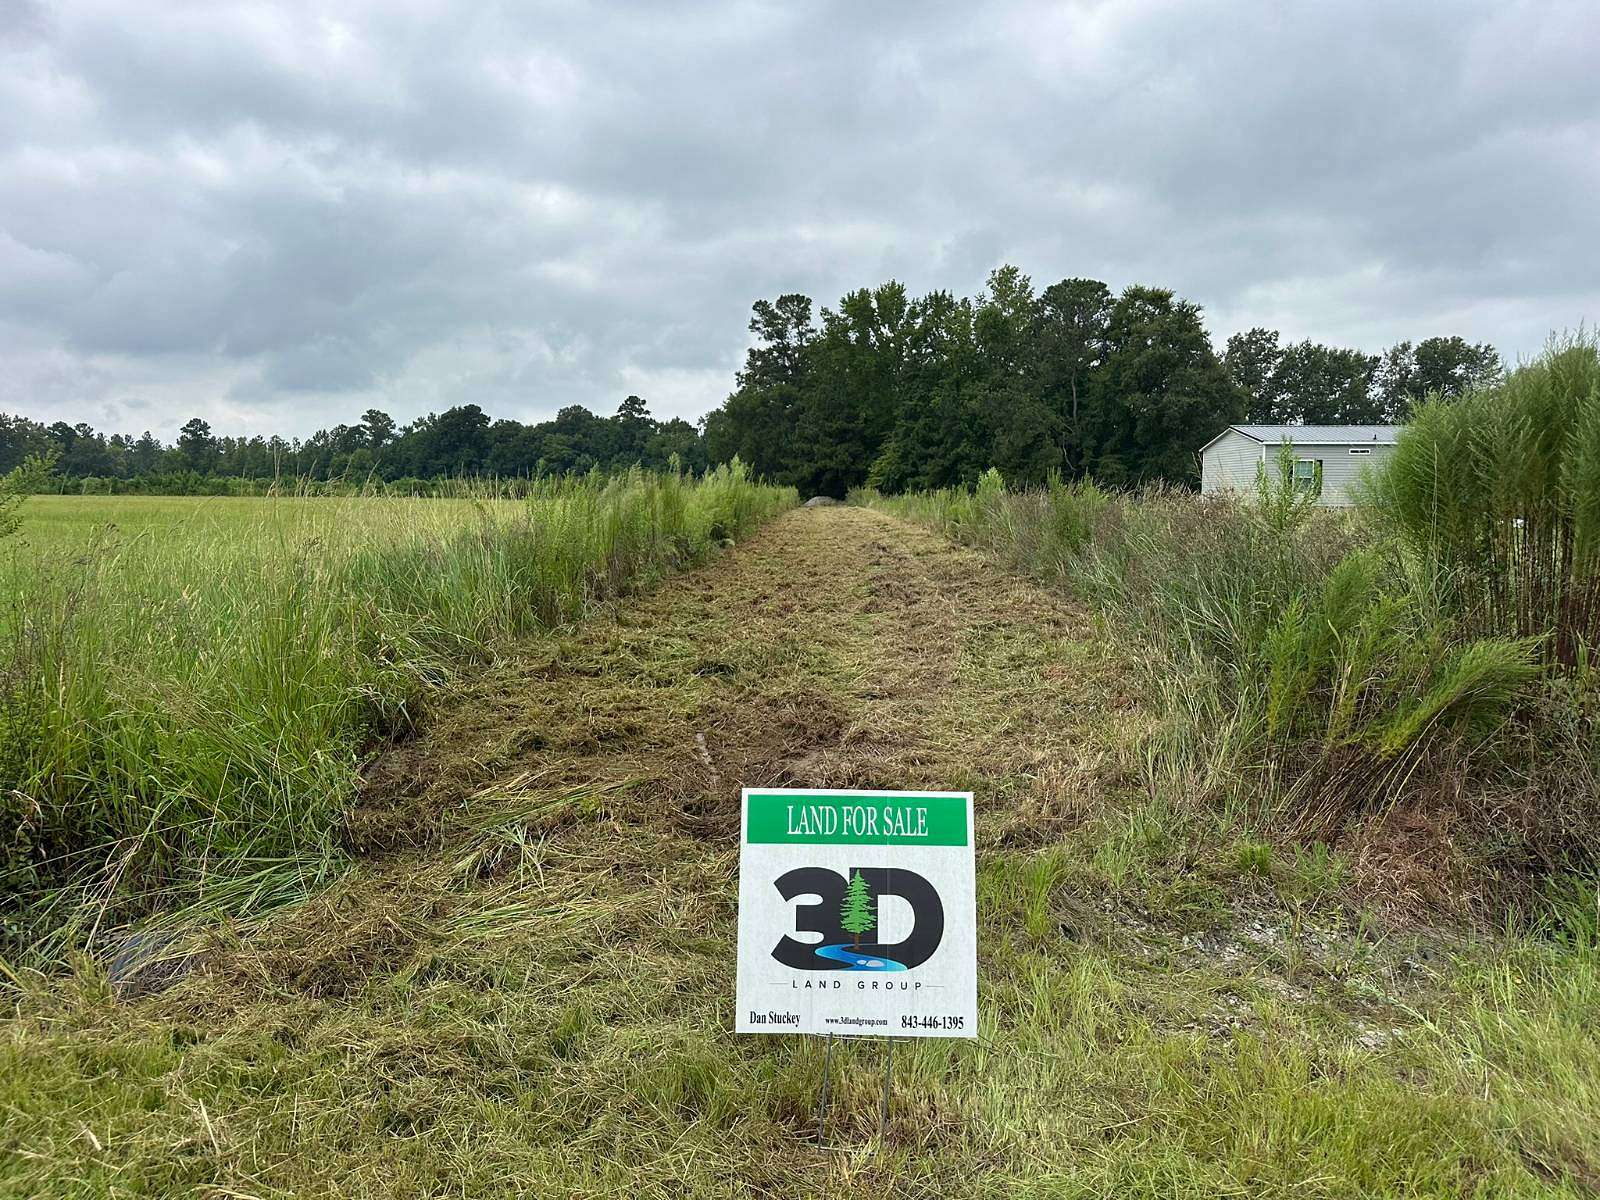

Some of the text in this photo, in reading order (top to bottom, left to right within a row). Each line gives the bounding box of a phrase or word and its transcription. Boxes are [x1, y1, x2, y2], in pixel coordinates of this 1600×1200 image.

[787, 805, 928, 837] LAND FOR SALE
[770, 866, 945, 972] 3D
[792, 980, 922, 991] LAND GROUP
[749, 1010, 801, 1027] Dan Stuckey
[825, 1016, 888, 1027] www.3dlandgroup.com
[901, 1015, 964, 1030] 843-446-1395
